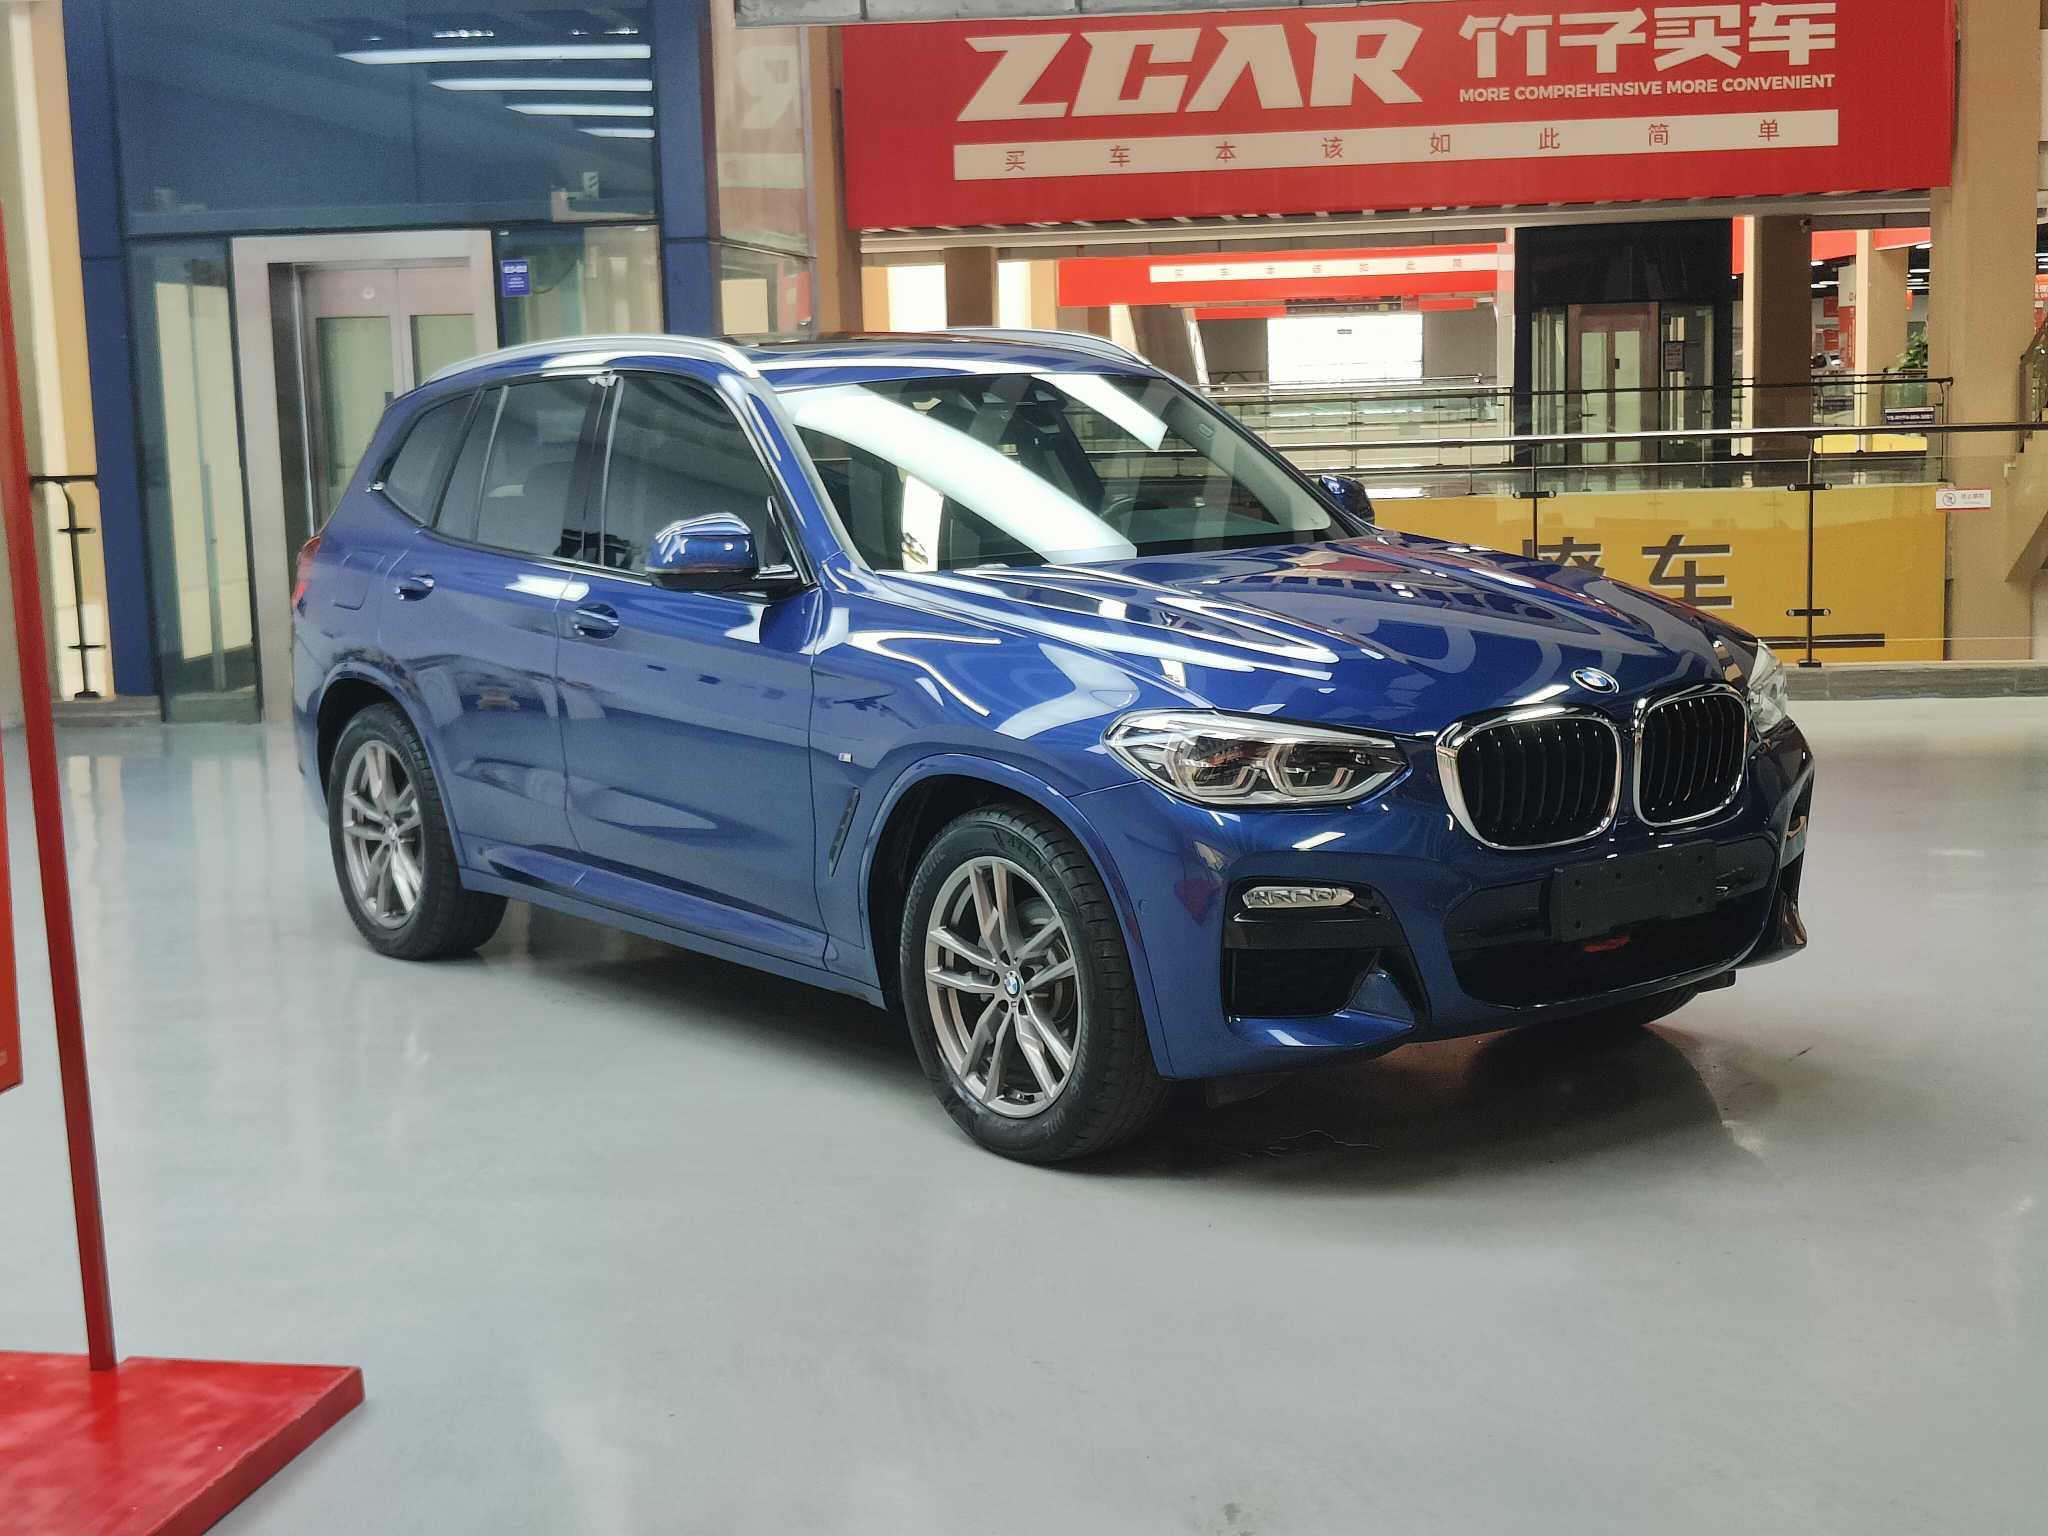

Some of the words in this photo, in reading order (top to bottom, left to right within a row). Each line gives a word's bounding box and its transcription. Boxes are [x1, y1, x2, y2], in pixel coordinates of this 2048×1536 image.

[956, 19, 1423, 122] ZCAR
[1459, 2, 1837, 78] 竹子买车
[1459, 87, 1511, 102] MORE
[1514, 81, 1663, 100] COMPREHENSIVE
[1666, 79, 1718, 94] MORE
[1721, 74, 1836, 92] CONVENIENT
[1005, 119, 1780, 172] 买车本该如此简单
